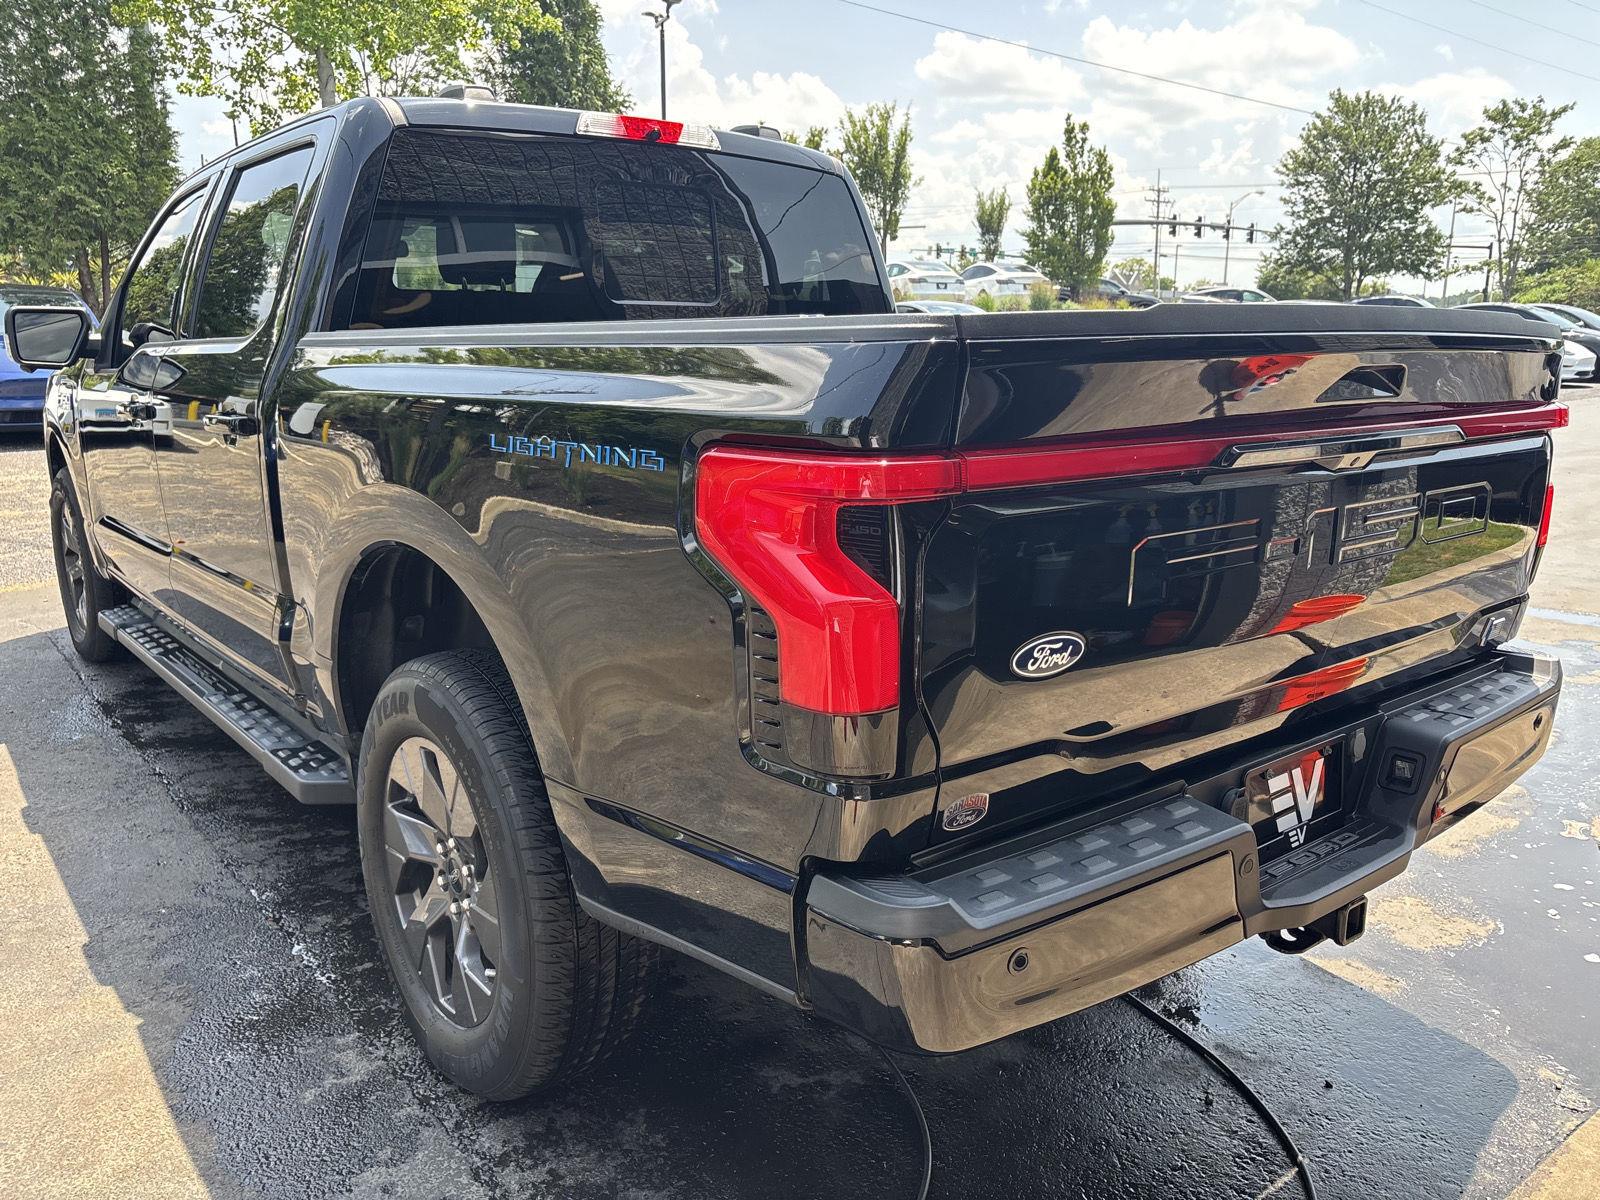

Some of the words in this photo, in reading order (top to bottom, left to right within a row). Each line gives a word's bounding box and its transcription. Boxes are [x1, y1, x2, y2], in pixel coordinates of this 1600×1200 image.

[489, 433, 665, 472] LIGHTNING
[1127, 480, 1493, 608] F-150
[1027, 641, 1073, 671] Ford
[946, 794, 988, 817] SARASOTA
[1267, 757, 1325, 833] EV
[953, 809, 978, 826] Ford
[1288, 825, 1307, 848] EV
